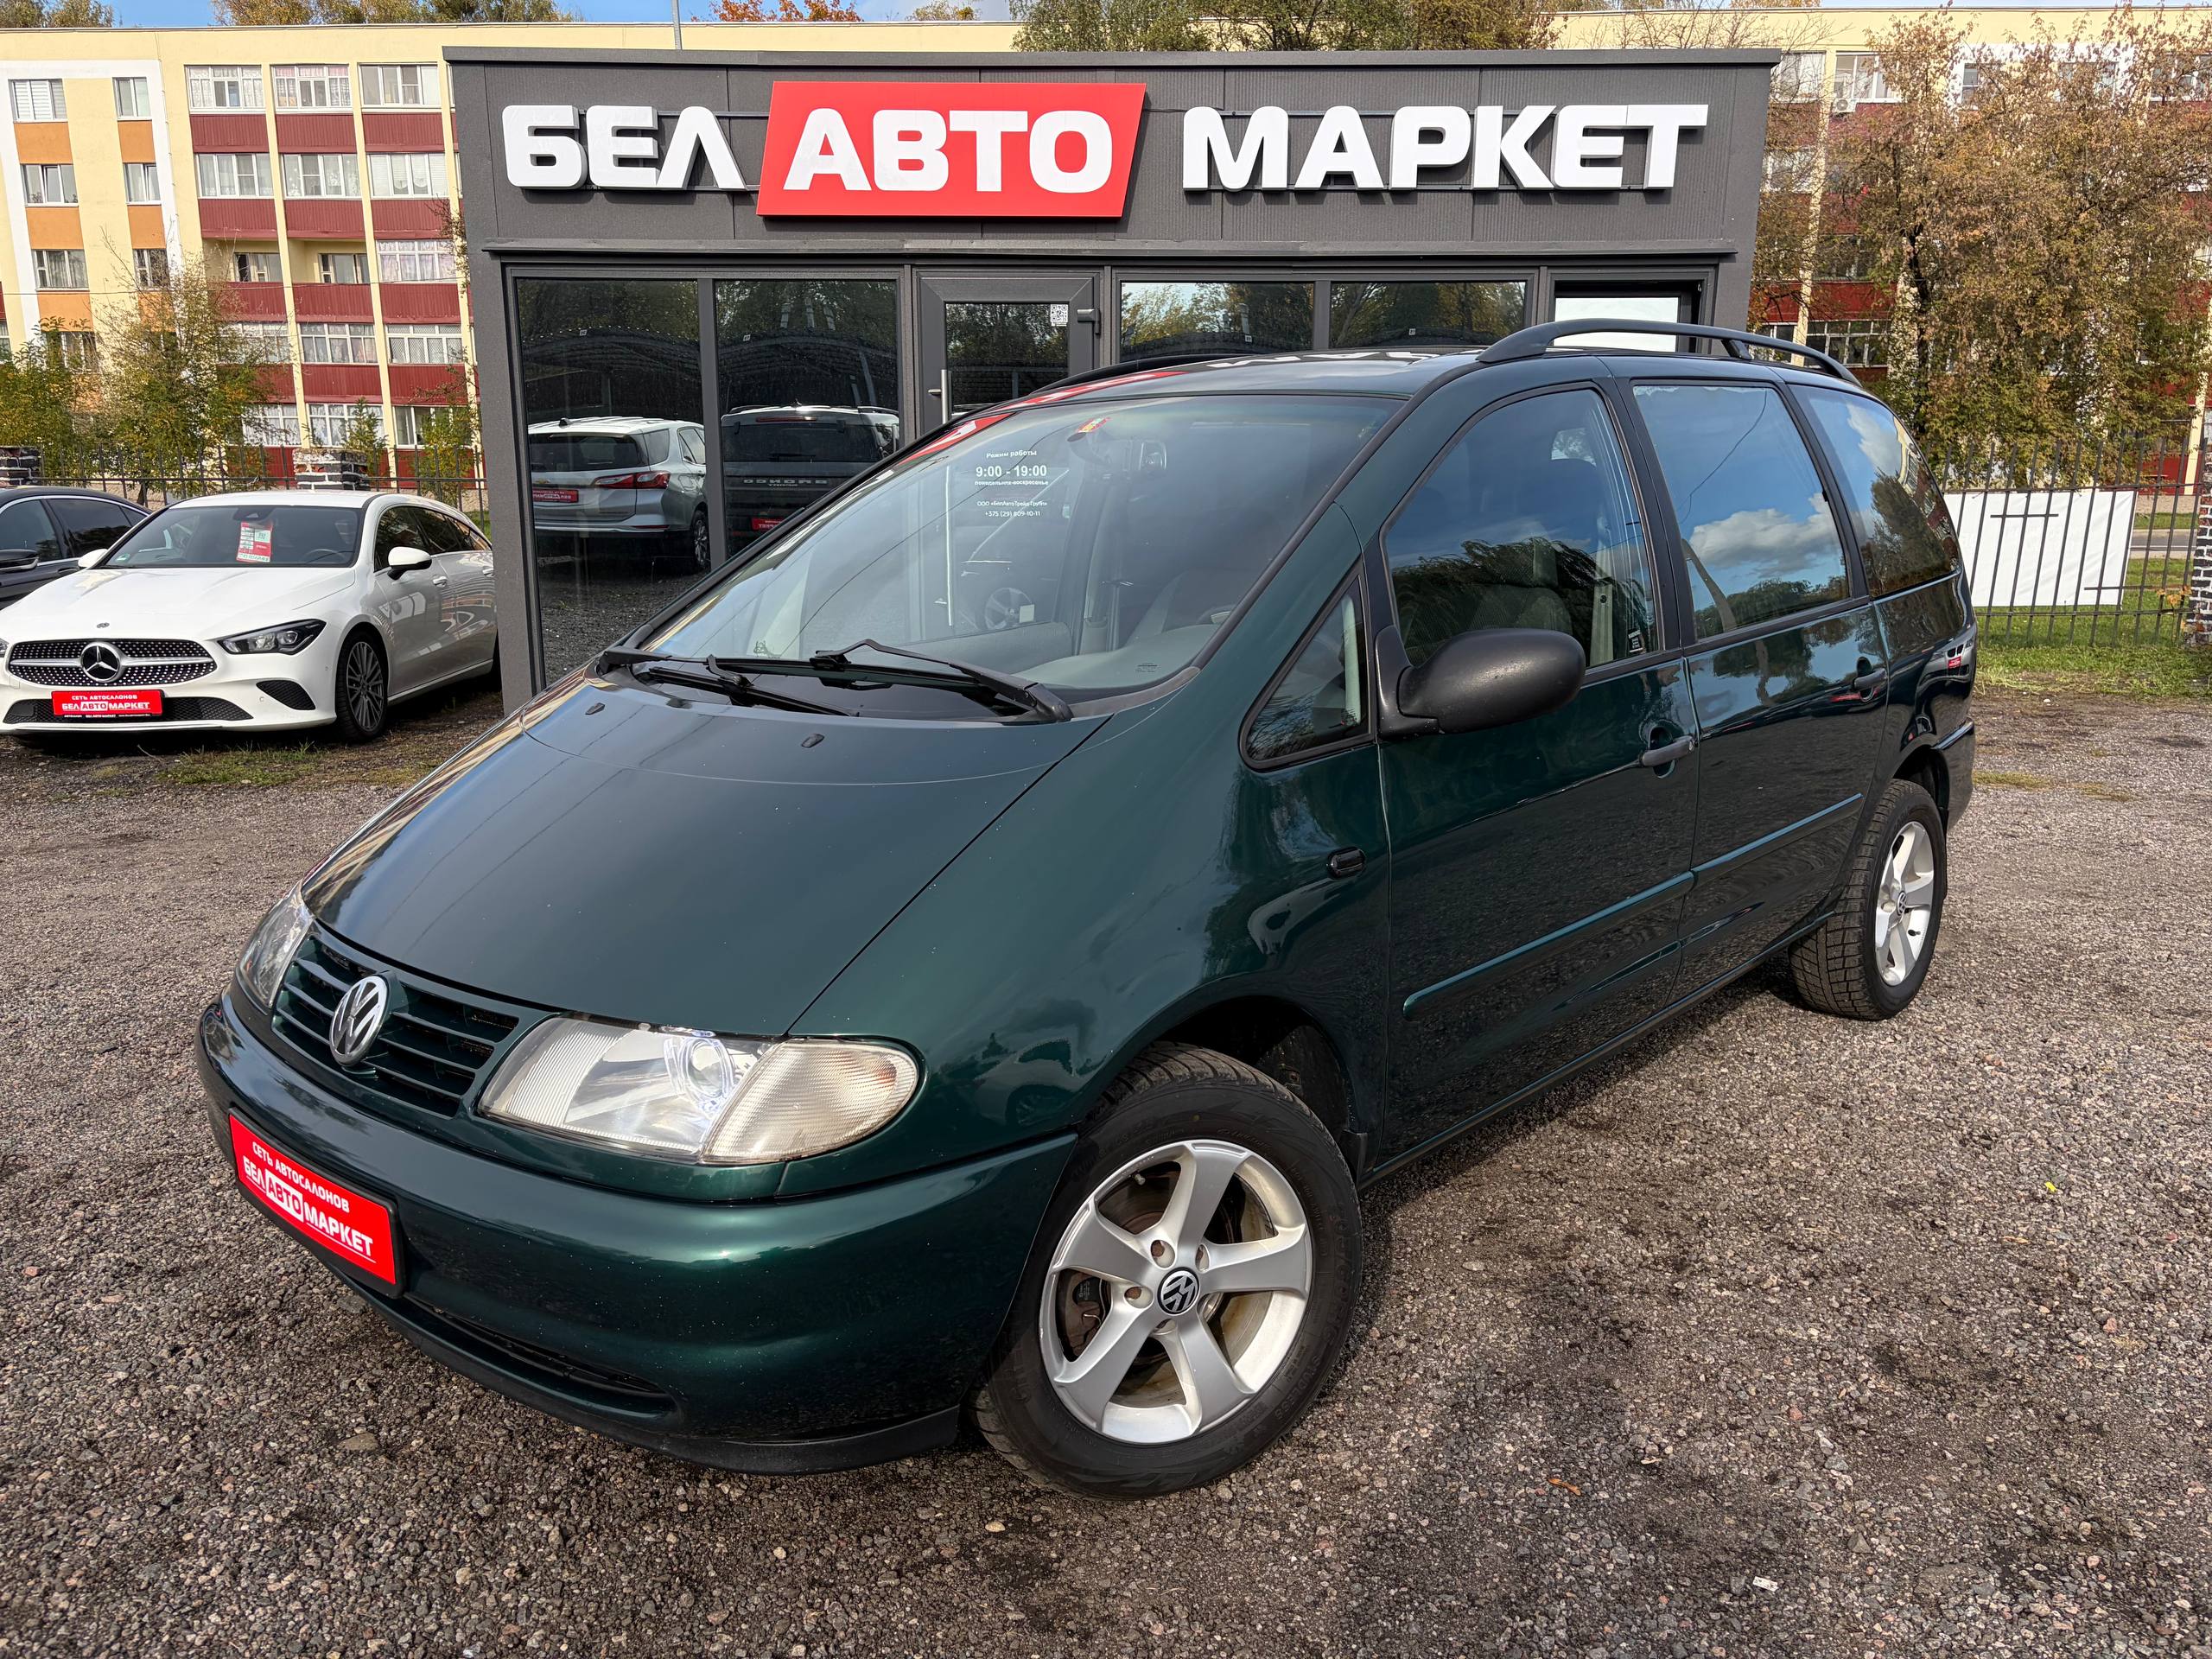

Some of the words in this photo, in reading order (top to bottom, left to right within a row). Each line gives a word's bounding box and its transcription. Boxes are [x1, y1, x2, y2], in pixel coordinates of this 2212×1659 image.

[502, 105, 747, 189] БЕЛ
[784, 109, 1113, 194] АВТО
[1183, 105, 1709, 189] МАРКЕТ
[976, 466, 1002, 477] 9:00
[1014, 465, 1047, 477] 19:00
[1010, 449, 1038, 458] работы
[243, 1155, 265, 1189] БЕЛ
[267, 1173, 302, 1212] АВТО
[304, 1201, 374, 1256] МАРКЕТ
[252, 1141, 274, 1167] СЕТЬ
[275, 1160, 350, 1213] АВТОСАЛОНОВ
